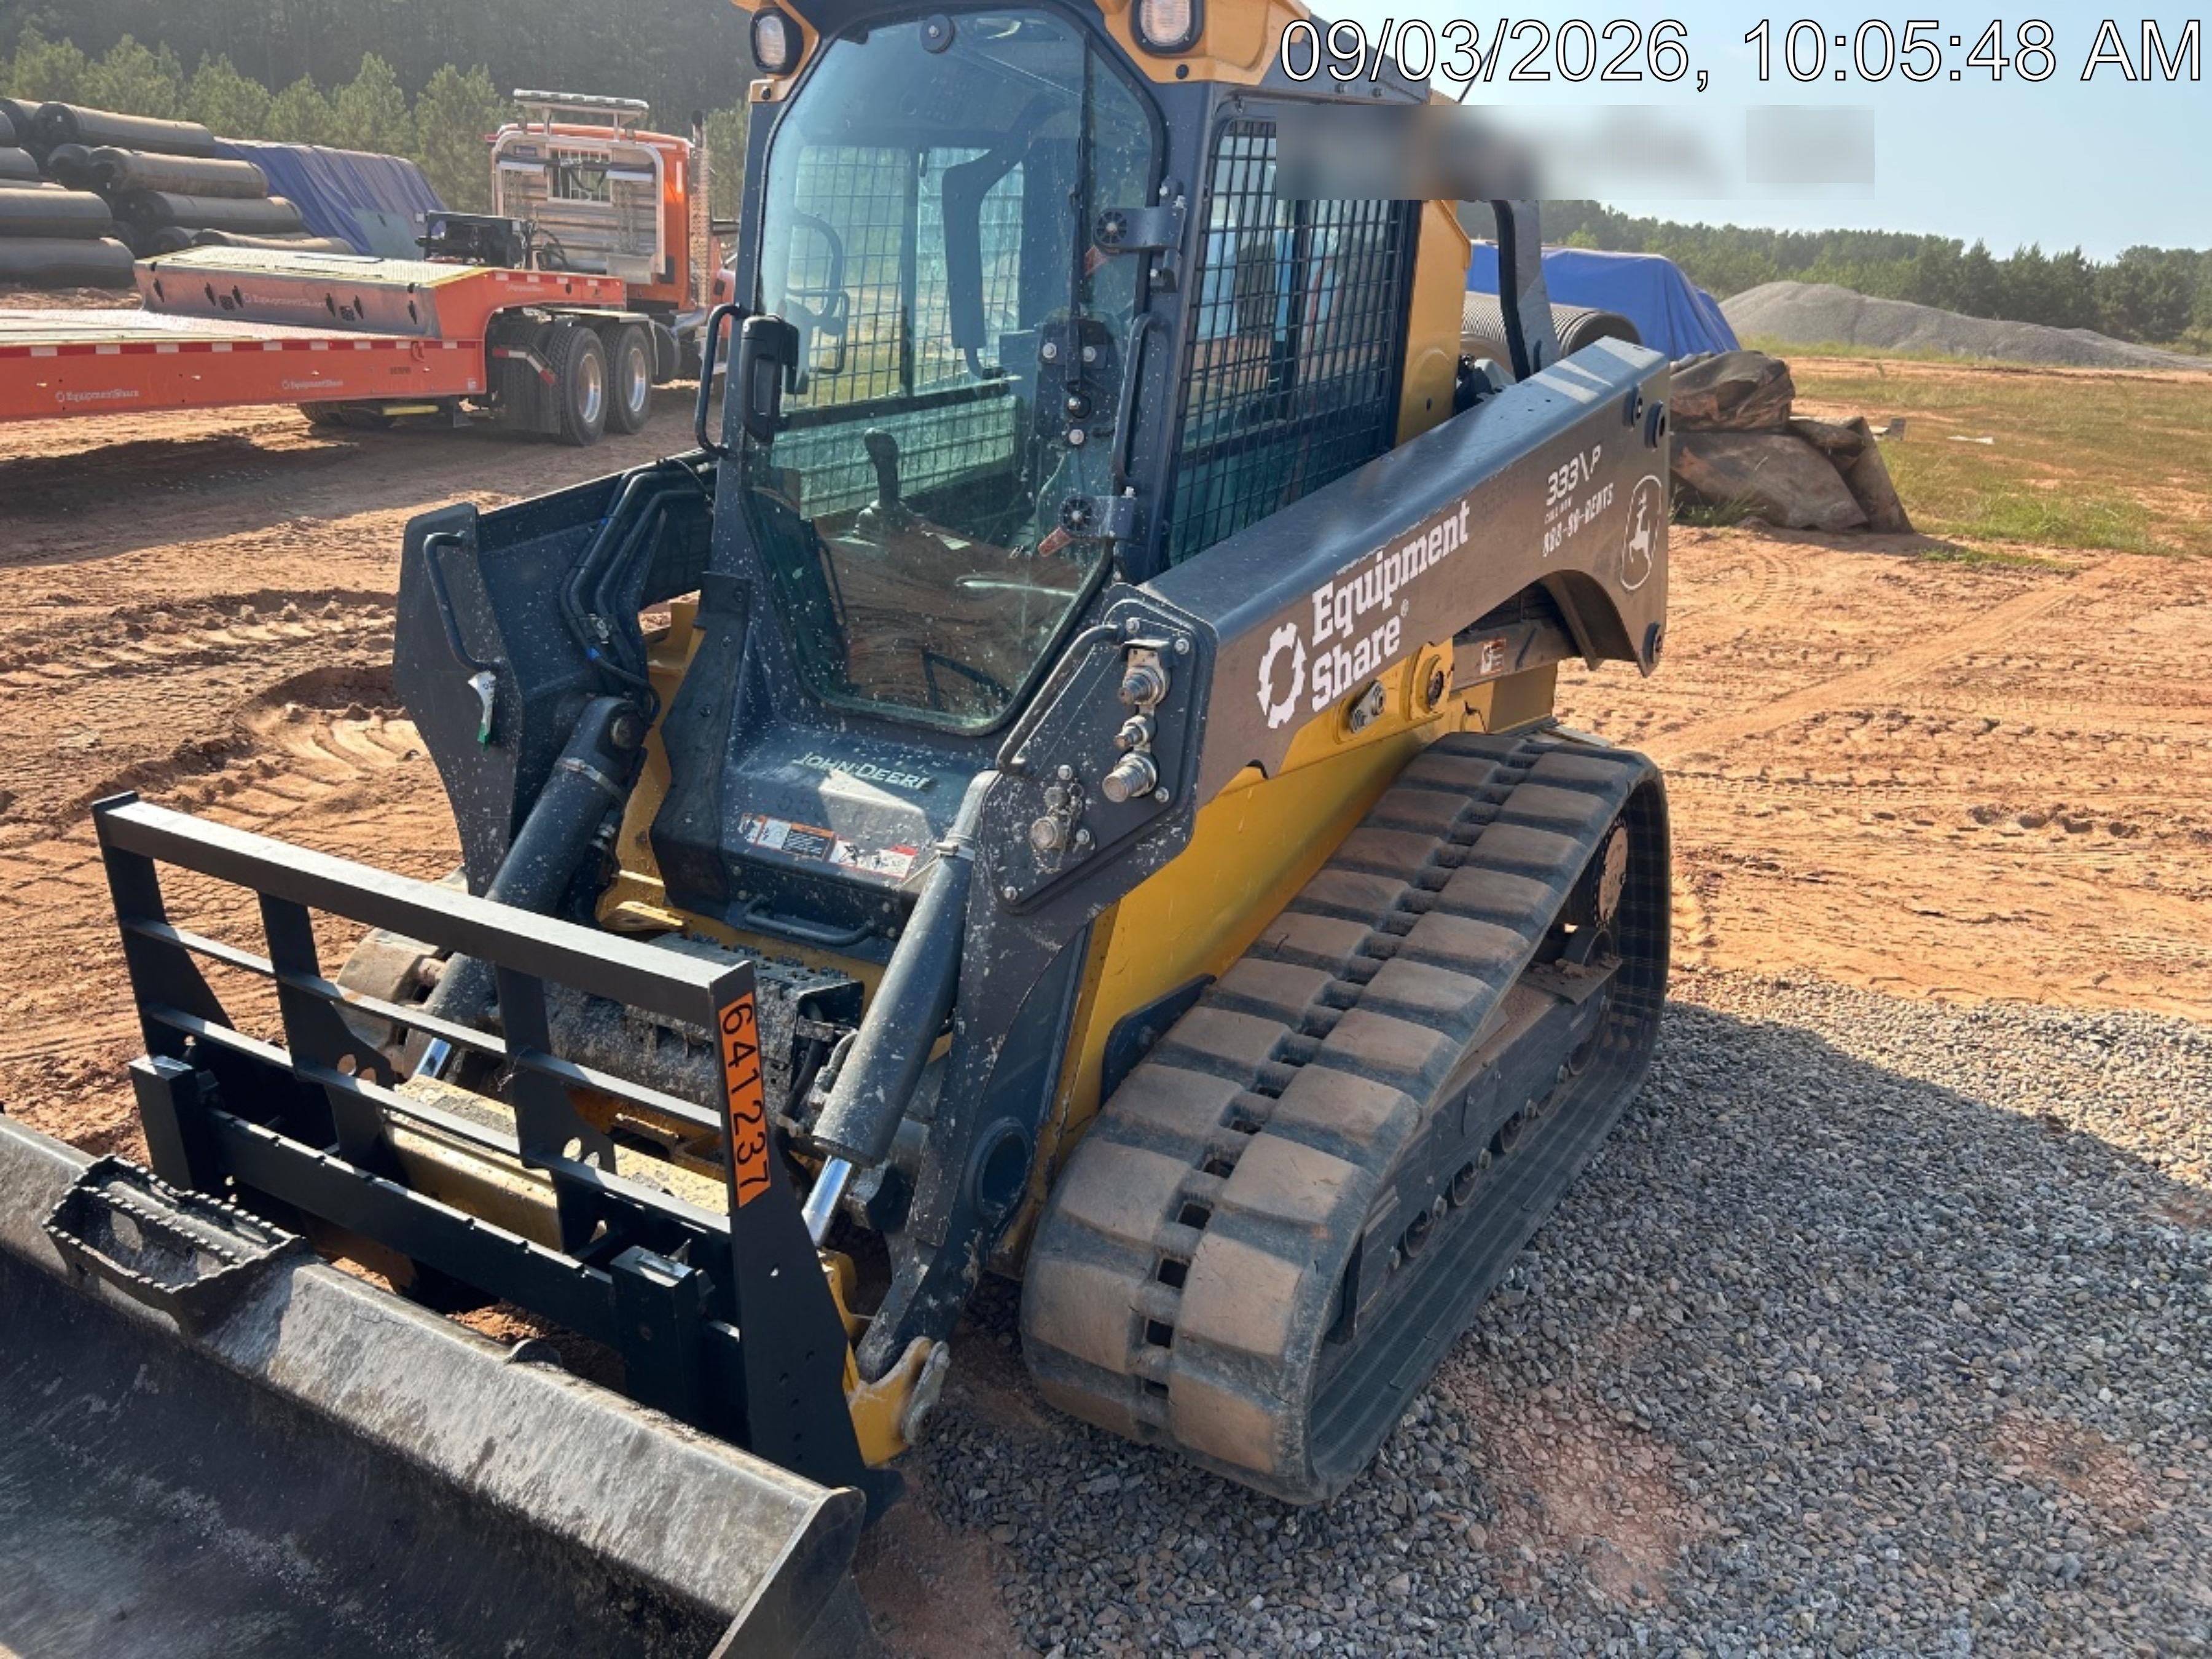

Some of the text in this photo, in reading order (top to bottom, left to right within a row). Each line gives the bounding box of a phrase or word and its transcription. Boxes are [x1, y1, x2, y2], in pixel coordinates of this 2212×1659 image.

[1311, 500, 1470, 648] Equipment
[792, 751, 855, 773] JOHN
[722, 1002, 769, 1189] 641237
